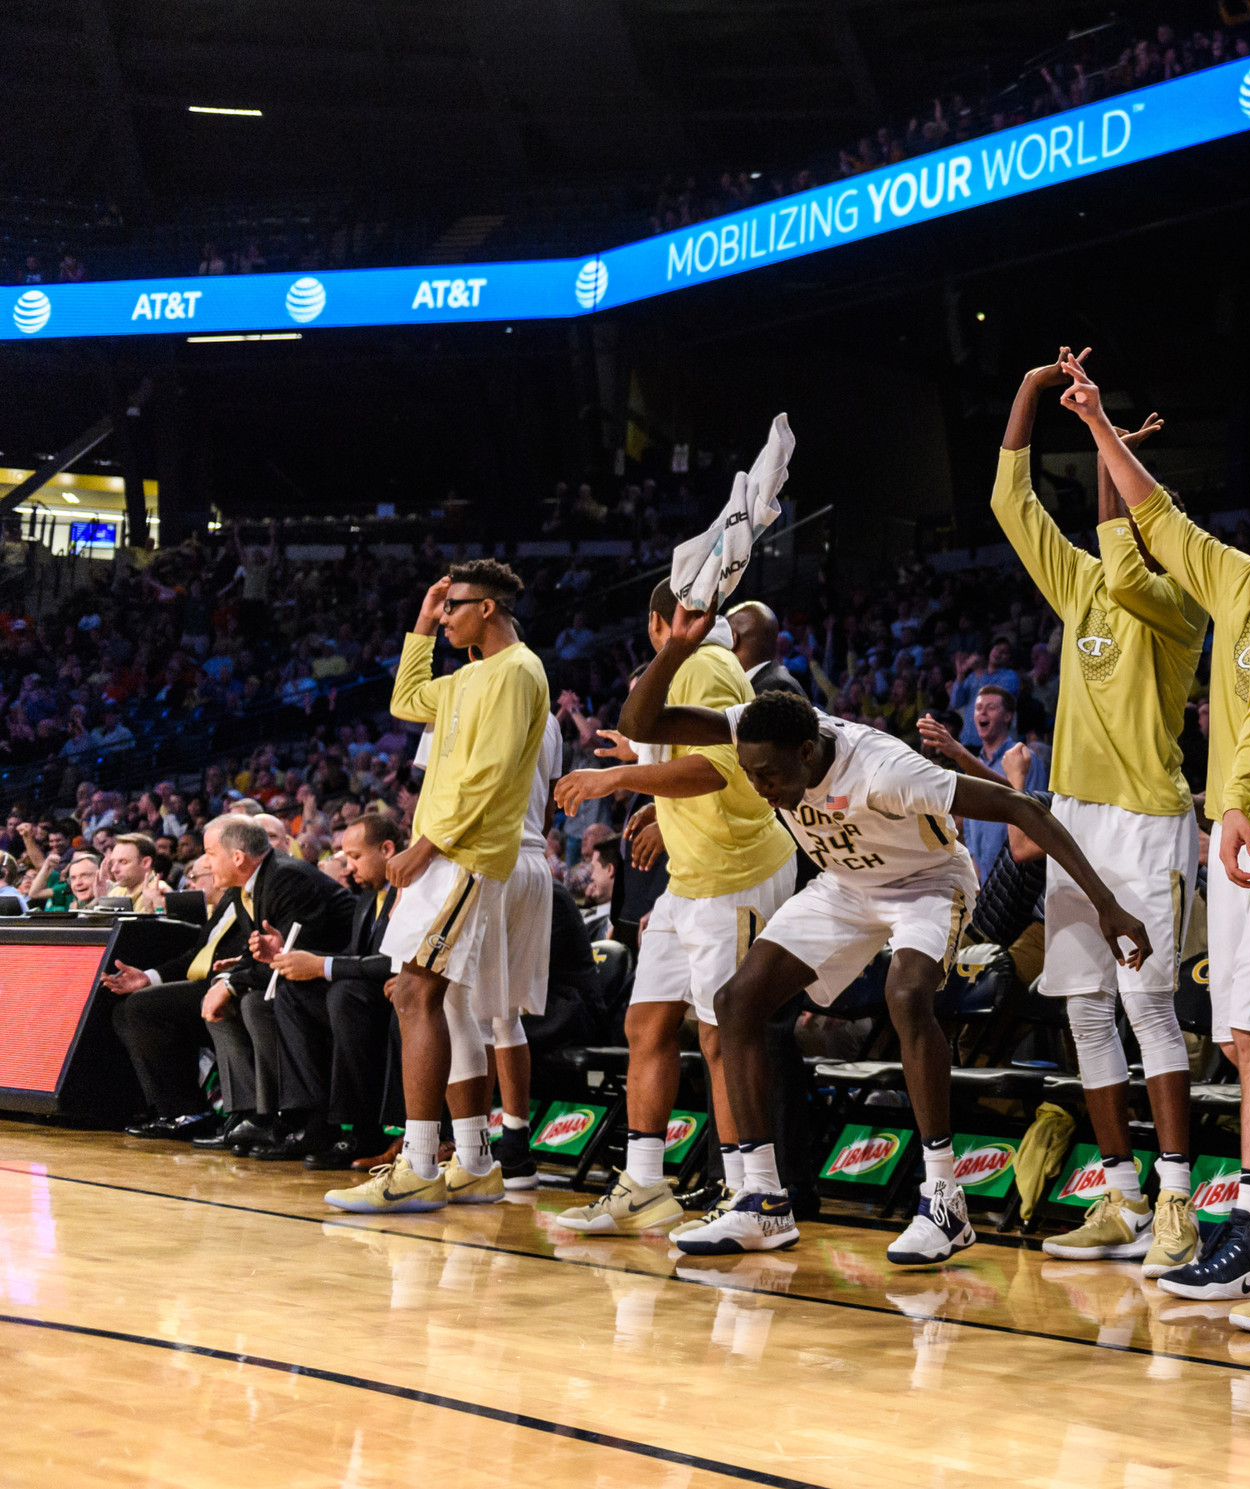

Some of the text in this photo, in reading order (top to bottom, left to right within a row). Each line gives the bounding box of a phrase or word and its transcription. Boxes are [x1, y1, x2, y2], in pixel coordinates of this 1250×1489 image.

[667, 189, 859, 281] MOBILIZING
[867, 155, 973, 223] YOUR
[131, 290, 202, 321] AT&T
[412, 278, 487, 309] AT&T
[534, 1116, 592, 1145] LIBMAN
[827, 1140, 896, 1176] LIBMAN
[953, 1151, 1012, 1179] IBMAN
[1057, 1167, 1107, 1200] LIBM
[1191, 1181, 1240, 1211] LIBM
